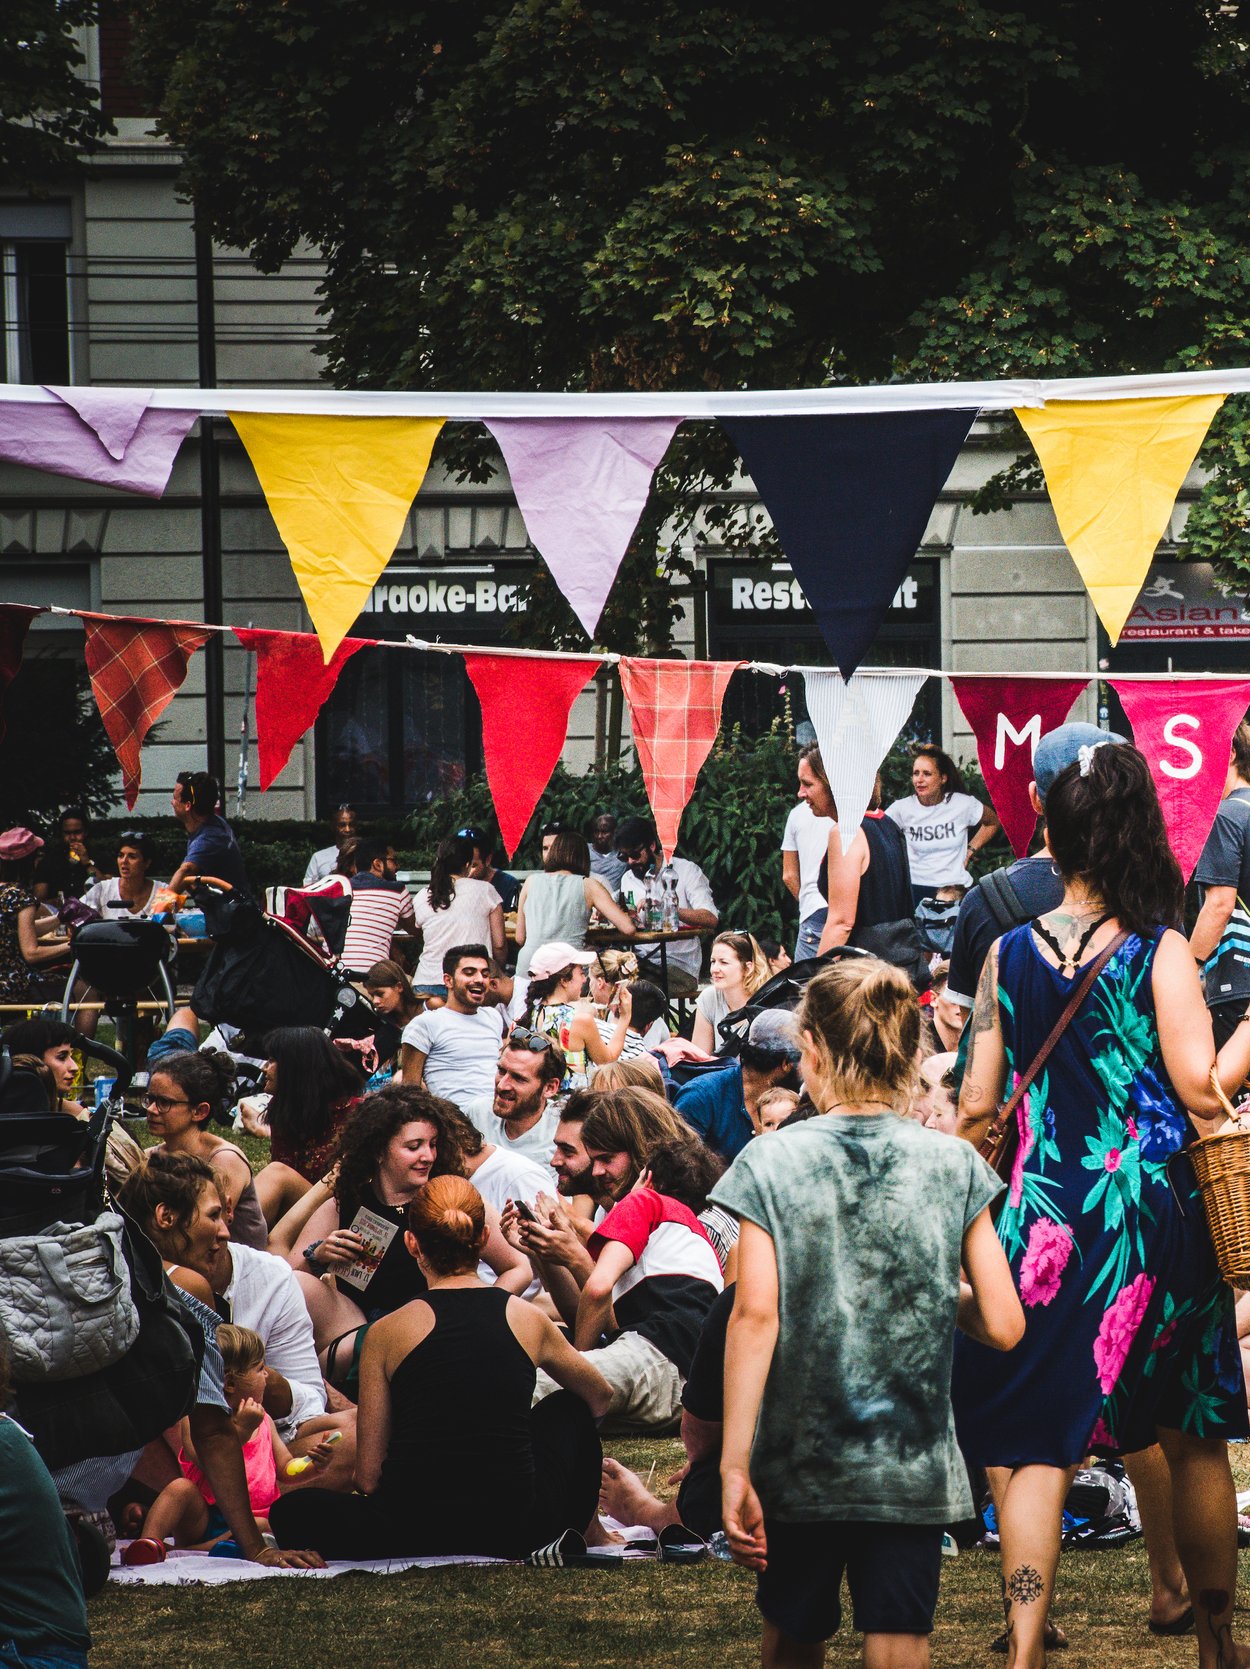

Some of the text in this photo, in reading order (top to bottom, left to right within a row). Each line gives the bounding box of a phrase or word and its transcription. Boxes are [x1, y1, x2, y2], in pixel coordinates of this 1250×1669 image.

[732, 575, 918, 610] Restt
[1122, 626, 1199, 637] restaurant
[1203, 626, 1215, 636] &
[1219, 625, 1250, 636] take
[994, 712, 1042, 771] M
[1159, 713, 1203, 780] S
[909, 822, 956, 842] MSCH
